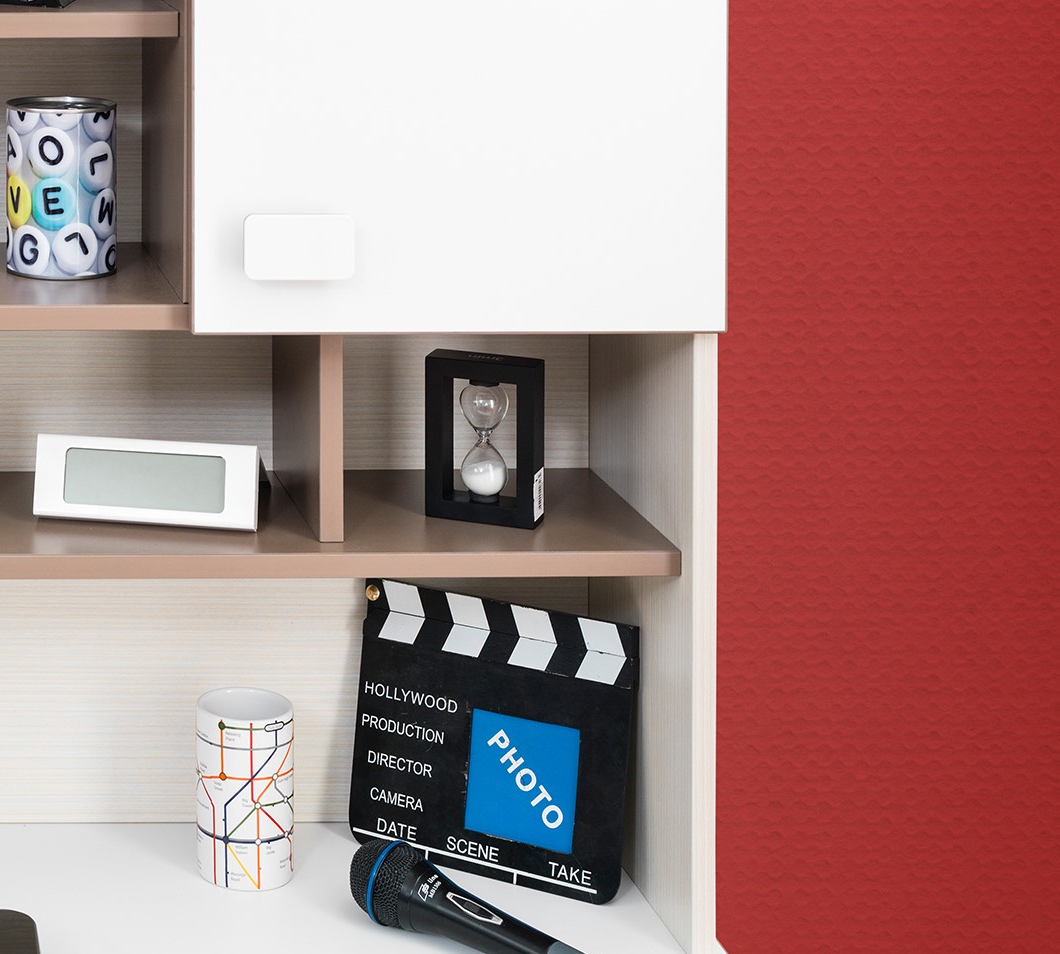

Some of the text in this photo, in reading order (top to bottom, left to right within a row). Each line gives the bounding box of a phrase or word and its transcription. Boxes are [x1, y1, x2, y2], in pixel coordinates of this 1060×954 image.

[364, 681, 458, 714] HOLLYWOOD
[361, 713, 445, 745] PRODUCTION
[367, 750, 433, 778] DIRECTOR
[487, 729, 564, 829] PHOTO
[370, 787, 424, 812] CAMERA
[377, 818, 592, 886] DATE SCENE TAKE
